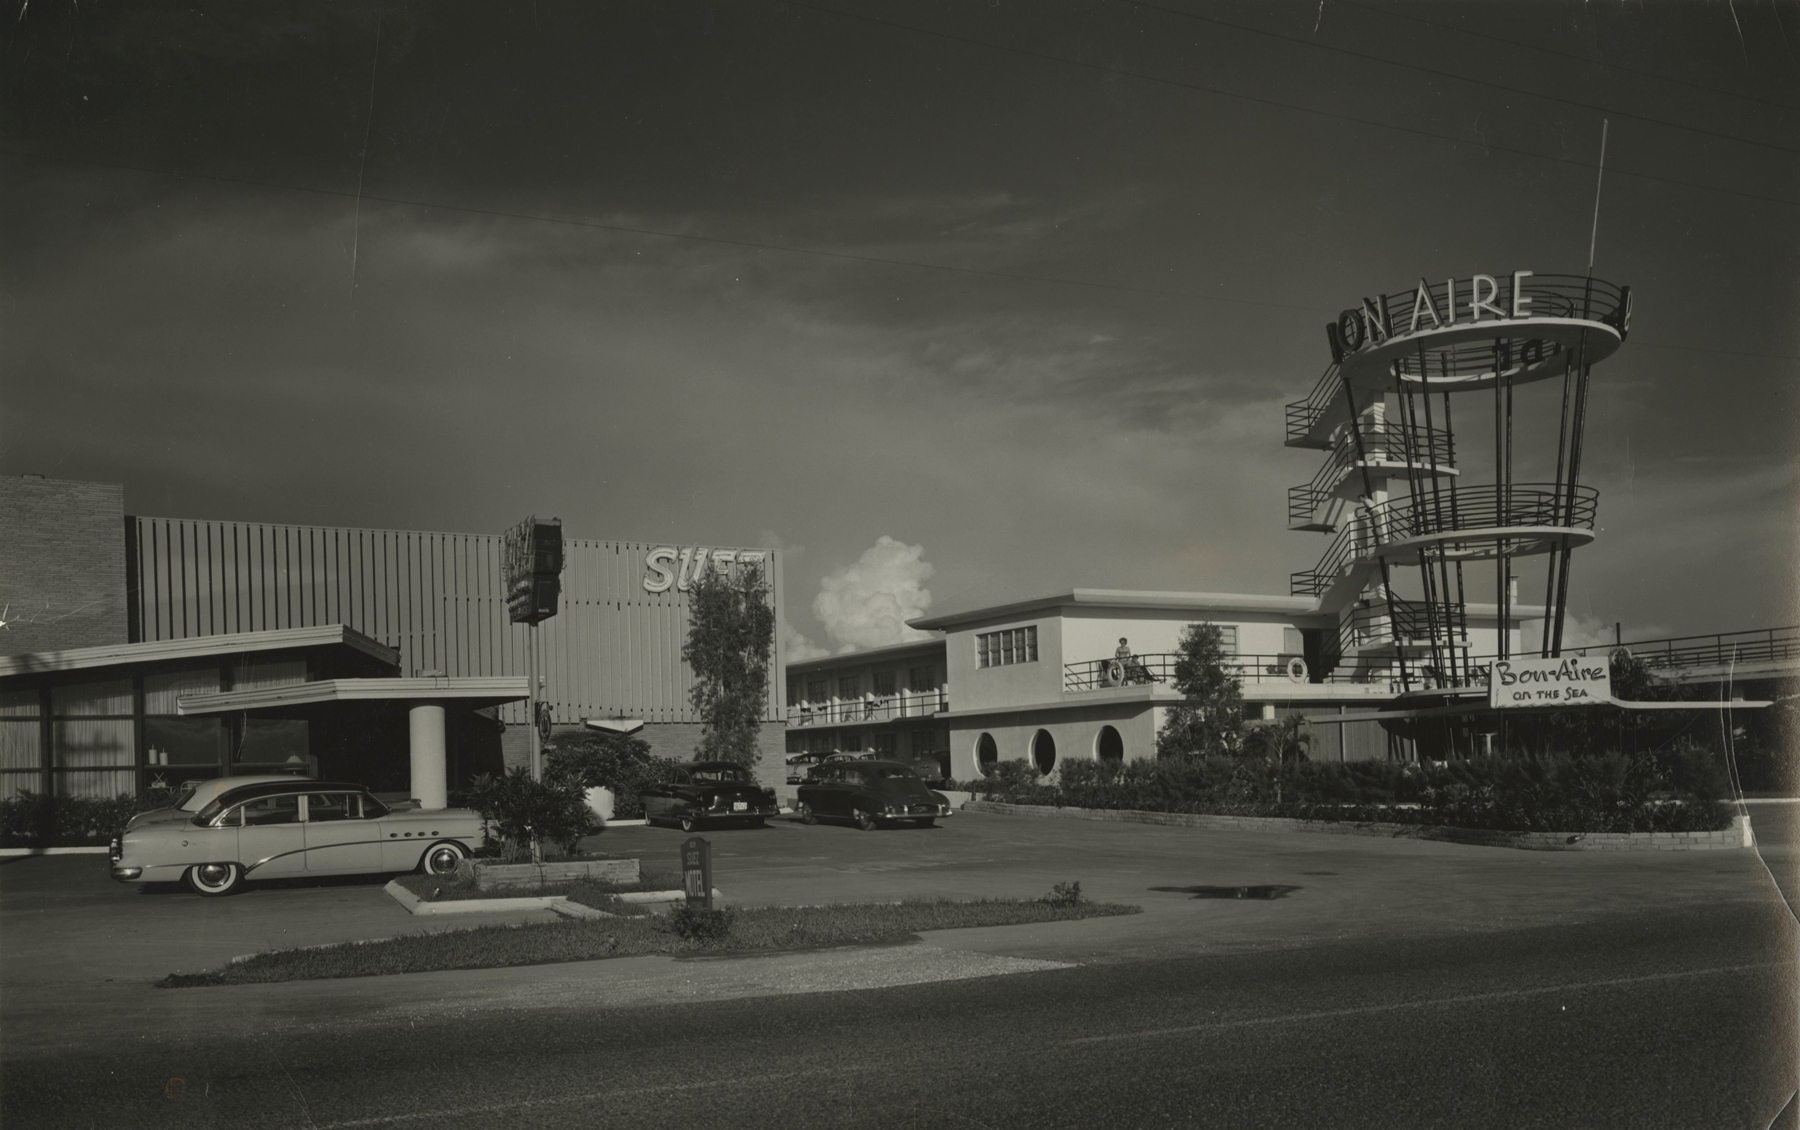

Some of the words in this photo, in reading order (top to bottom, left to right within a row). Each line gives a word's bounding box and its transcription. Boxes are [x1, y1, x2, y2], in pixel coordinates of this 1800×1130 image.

[1327, 294, 1393, 364] ON
[1411, 270, 1533, 333] AIRE
[1497, 658, 1607, 686] Bon-Aire
[1536, 689, 1560, 700] THE
[686, 851, 700, 866] SUEZ
[684, 869, 706, 897] MOTEL
